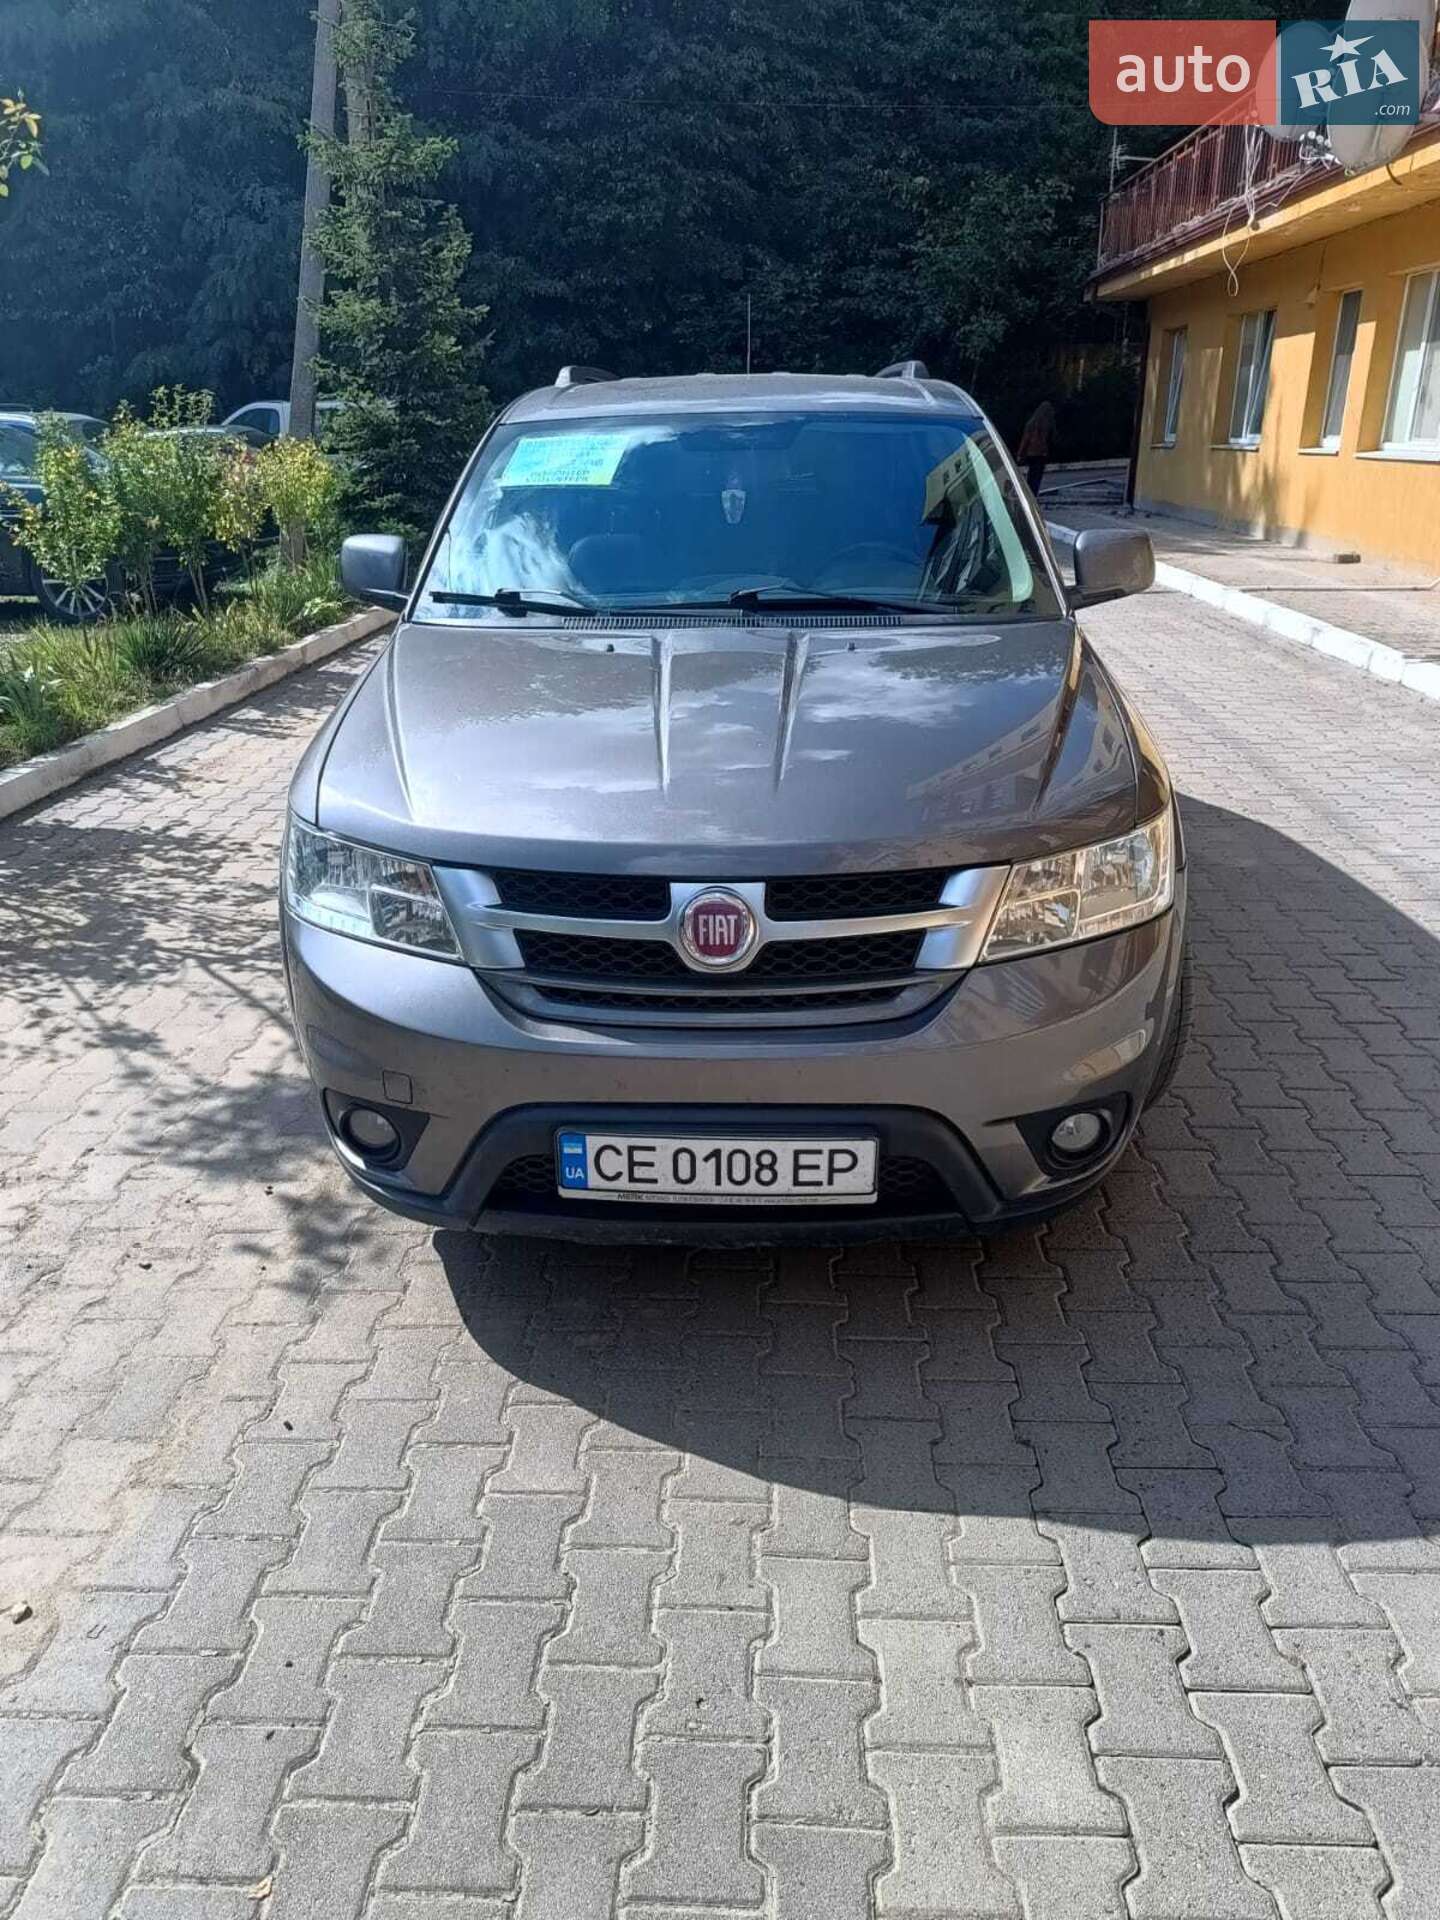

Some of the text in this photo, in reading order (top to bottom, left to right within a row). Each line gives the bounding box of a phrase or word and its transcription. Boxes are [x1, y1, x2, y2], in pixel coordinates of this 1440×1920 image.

[698, 915, 738, 945] FIAT
[565, 1167, 585, 1179] UA
[593, 1144, 859, 1187] CE 0108 EP
